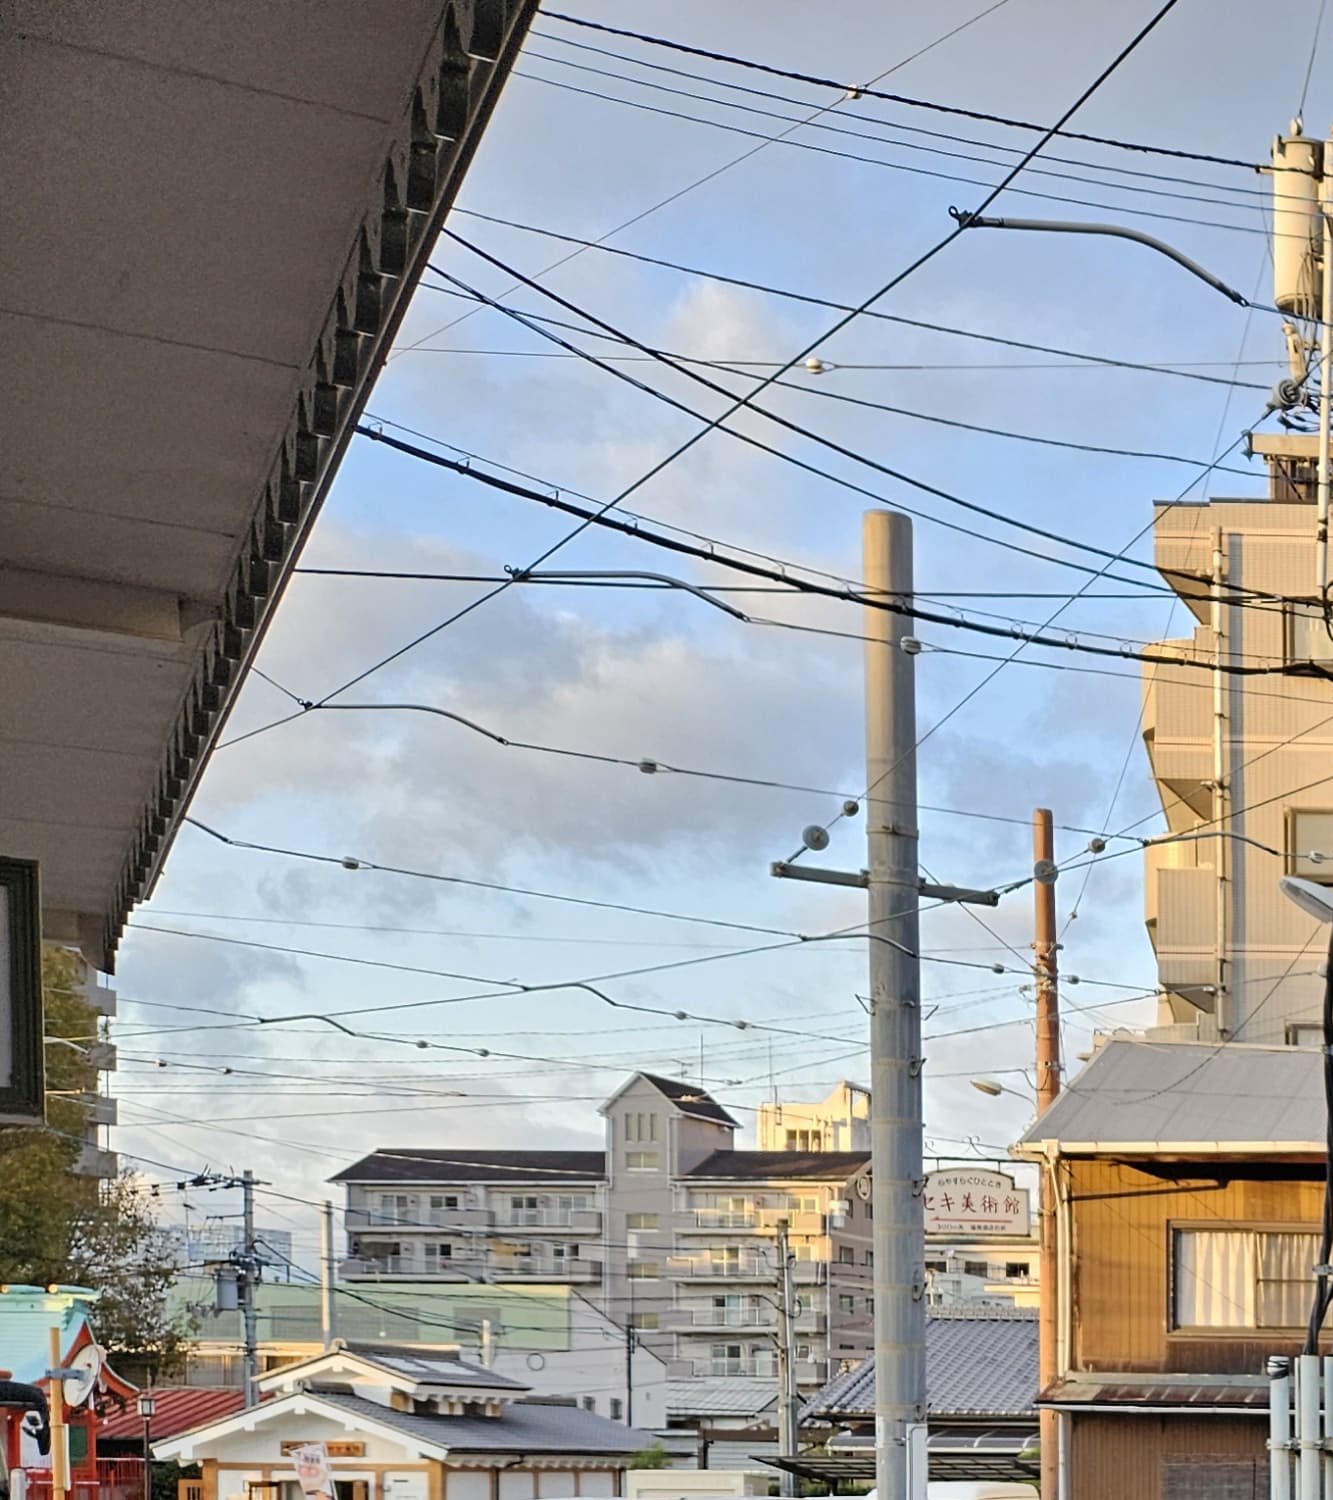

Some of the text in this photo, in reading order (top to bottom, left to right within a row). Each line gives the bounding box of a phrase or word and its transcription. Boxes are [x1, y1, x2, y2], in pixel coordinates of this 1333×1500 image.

[922, 1191, 1020, 1215] セキ美術館
